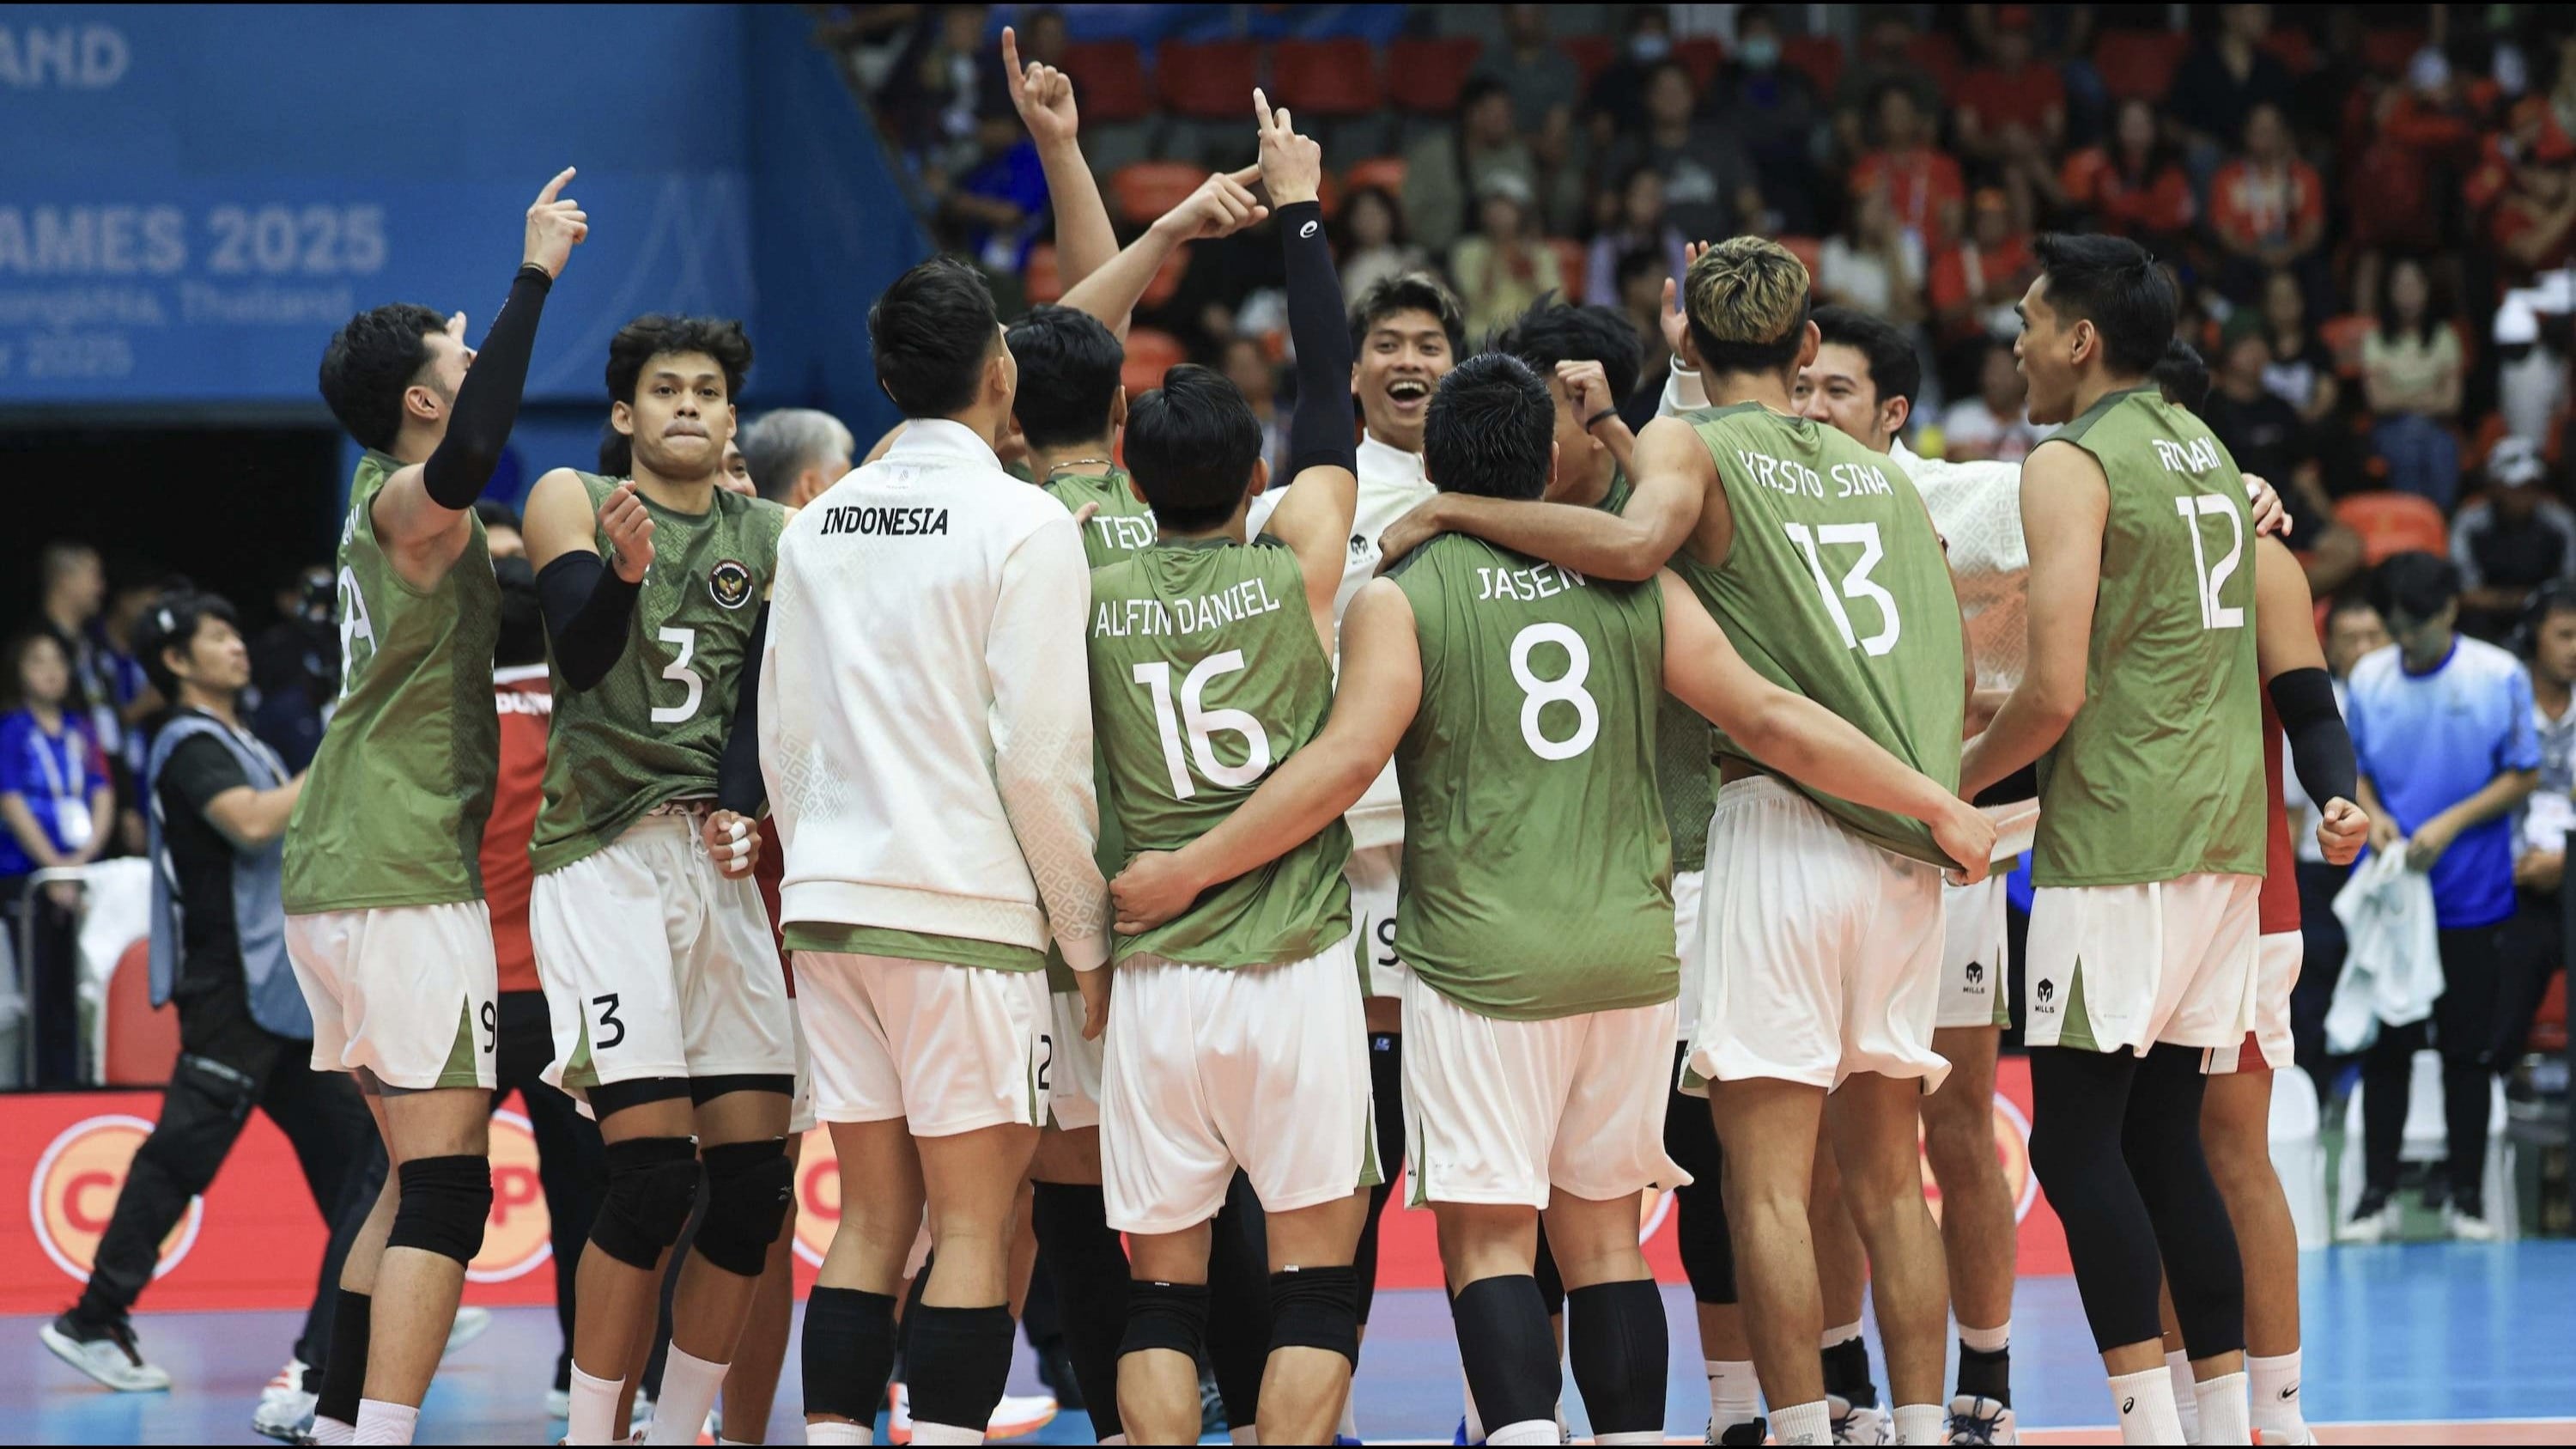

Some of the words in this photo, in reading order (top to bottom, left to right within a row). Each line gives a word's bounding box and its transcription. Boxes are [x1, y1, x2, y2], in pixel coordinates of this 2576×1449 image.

[208, 206, 387, 272] 2025
[1831, 463, 1893, 498] SINA
[820, 506, 949, 535] INDONESIA
[1477, 562, 1586, 600] JASEN
[1784, 521, 1901, 656] 13
[2175, 493, 2244, 630] 12
[1095, 599, 1173, 638] ALFIN
[1174, 577, 1280, 635] DANIEL
[651, 626, 703, 723] 3
[1510, 622, 1600, 761] 8
[1133, 648, 1271, 801] 16
[481, 1001, 496, 1053] 9
[592, 993, 625, 1050] 3
[2035, 1005, 2055, 1014] MILLS
[1038, 1034, 1053, 1090] 2
